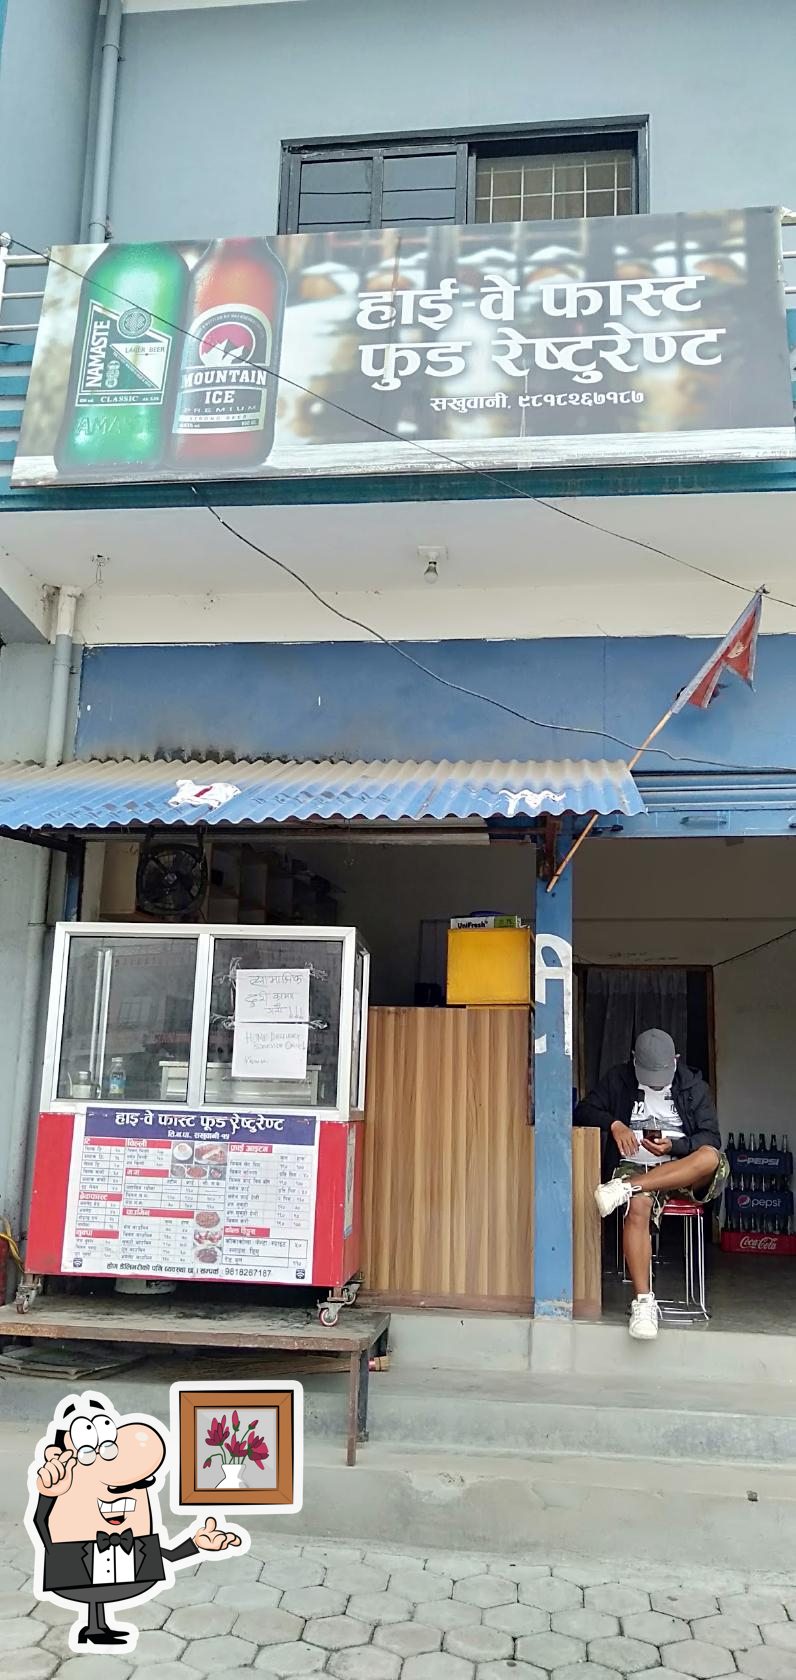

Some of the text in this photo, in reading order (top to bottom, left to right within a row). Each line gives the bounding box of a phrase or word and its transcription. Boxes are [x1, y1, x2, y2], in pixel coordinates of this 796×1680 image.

[356, 275, 706, 331] हाई-वे फास्ट
[85, 319, 111, 388] NAMASTE
[358, 322, 727, 391] फुड रेष्टुरेण्ट
[182, 369, 267, 388] MOUNTAIN
[100, 395, 139, 403] CLASSIC
[204, 390, 236, 404] ICE
[183, 405, 257, 413] PREMIUM
[158, 1113, 197, 1128] फास्ट
[752, 1198, 782, 1208] pepsi
